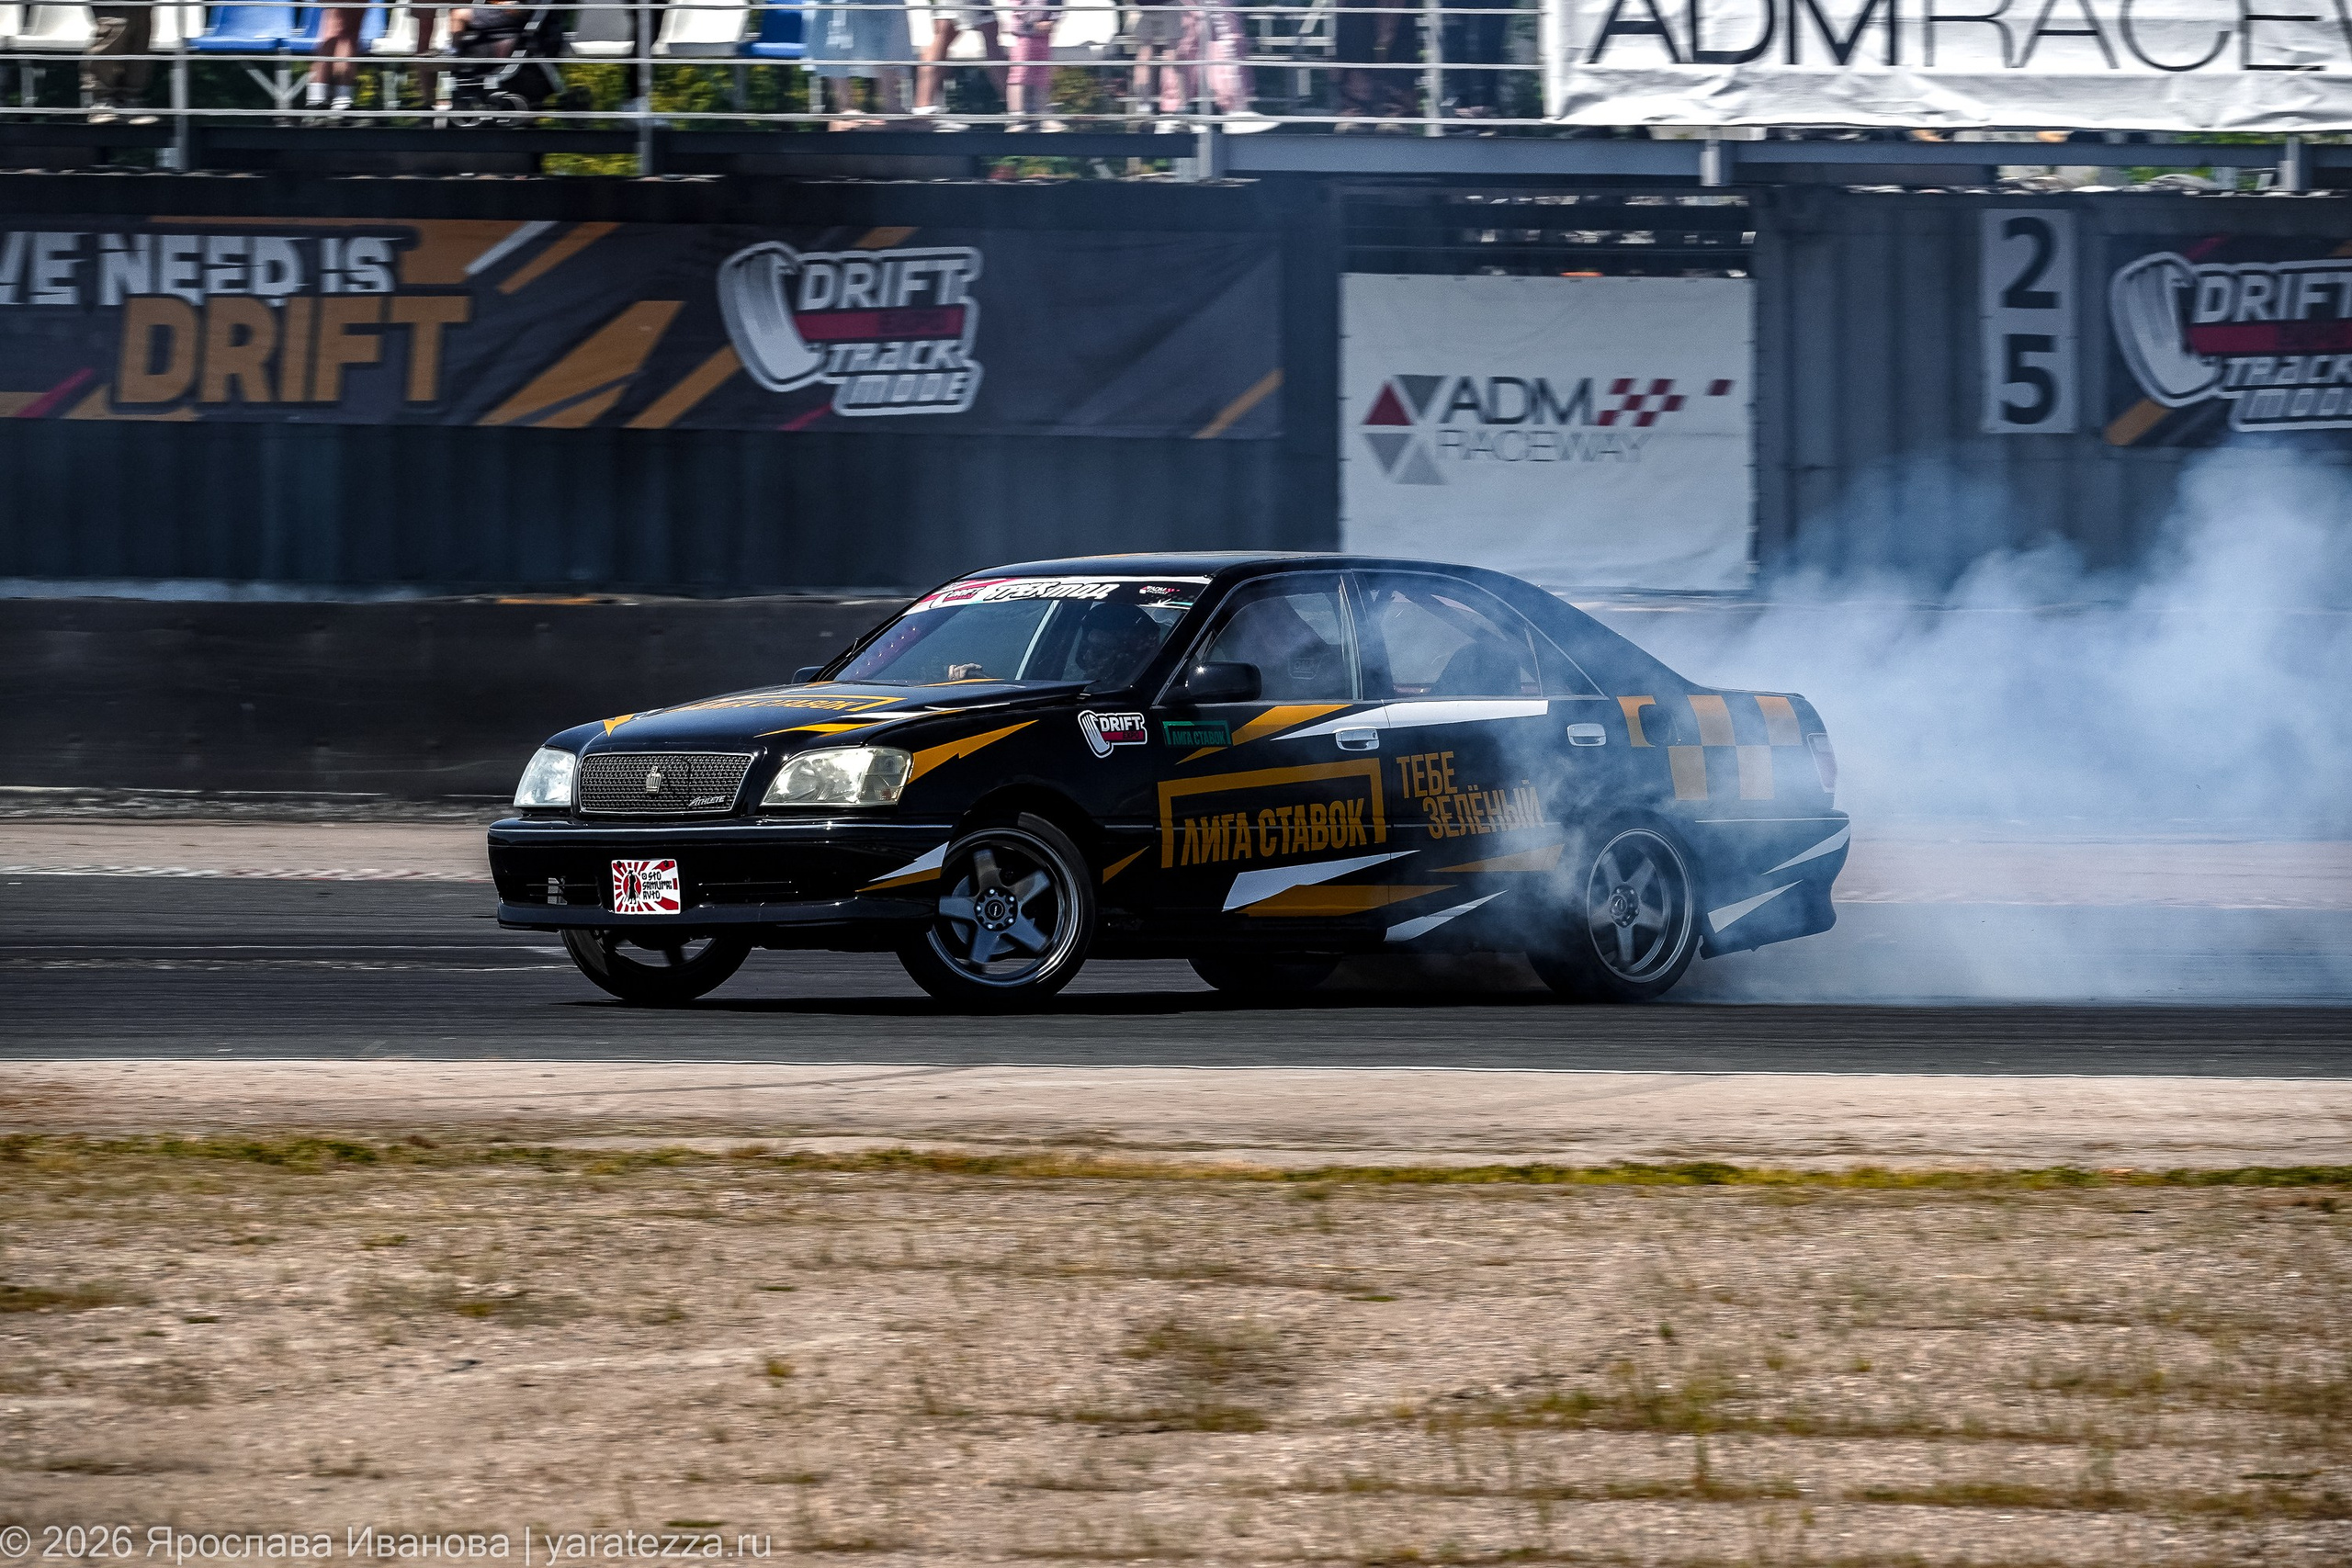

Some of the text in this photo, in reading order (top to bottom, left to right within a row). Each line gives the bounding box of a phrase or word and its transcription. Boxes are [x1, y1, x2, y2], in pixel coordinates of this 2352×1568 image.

[1922, 0, 2352, 71] RACE
[97, 233, 303, 306] NEED
[320, 236, 396, 293] IS
[796, 258, 966, 310] DRIFT
[116, 296, 472, 403] DRIFT
[1437, 376, 1594, 425] ADM
[1435, 429, 1655, 462] RACEWAY
[1100, 716, 1142, 732] DRIFT
[1172, 730, 1227, 745] ЛИГА СТАВОК
[1396, 750, 1458, 799] ТЕБЕ
[1181, 797, 1368, 866] ЛИГА СТАВОК
[1422, 779, 1546, 840] ЗЕЛЁНЫЙ
